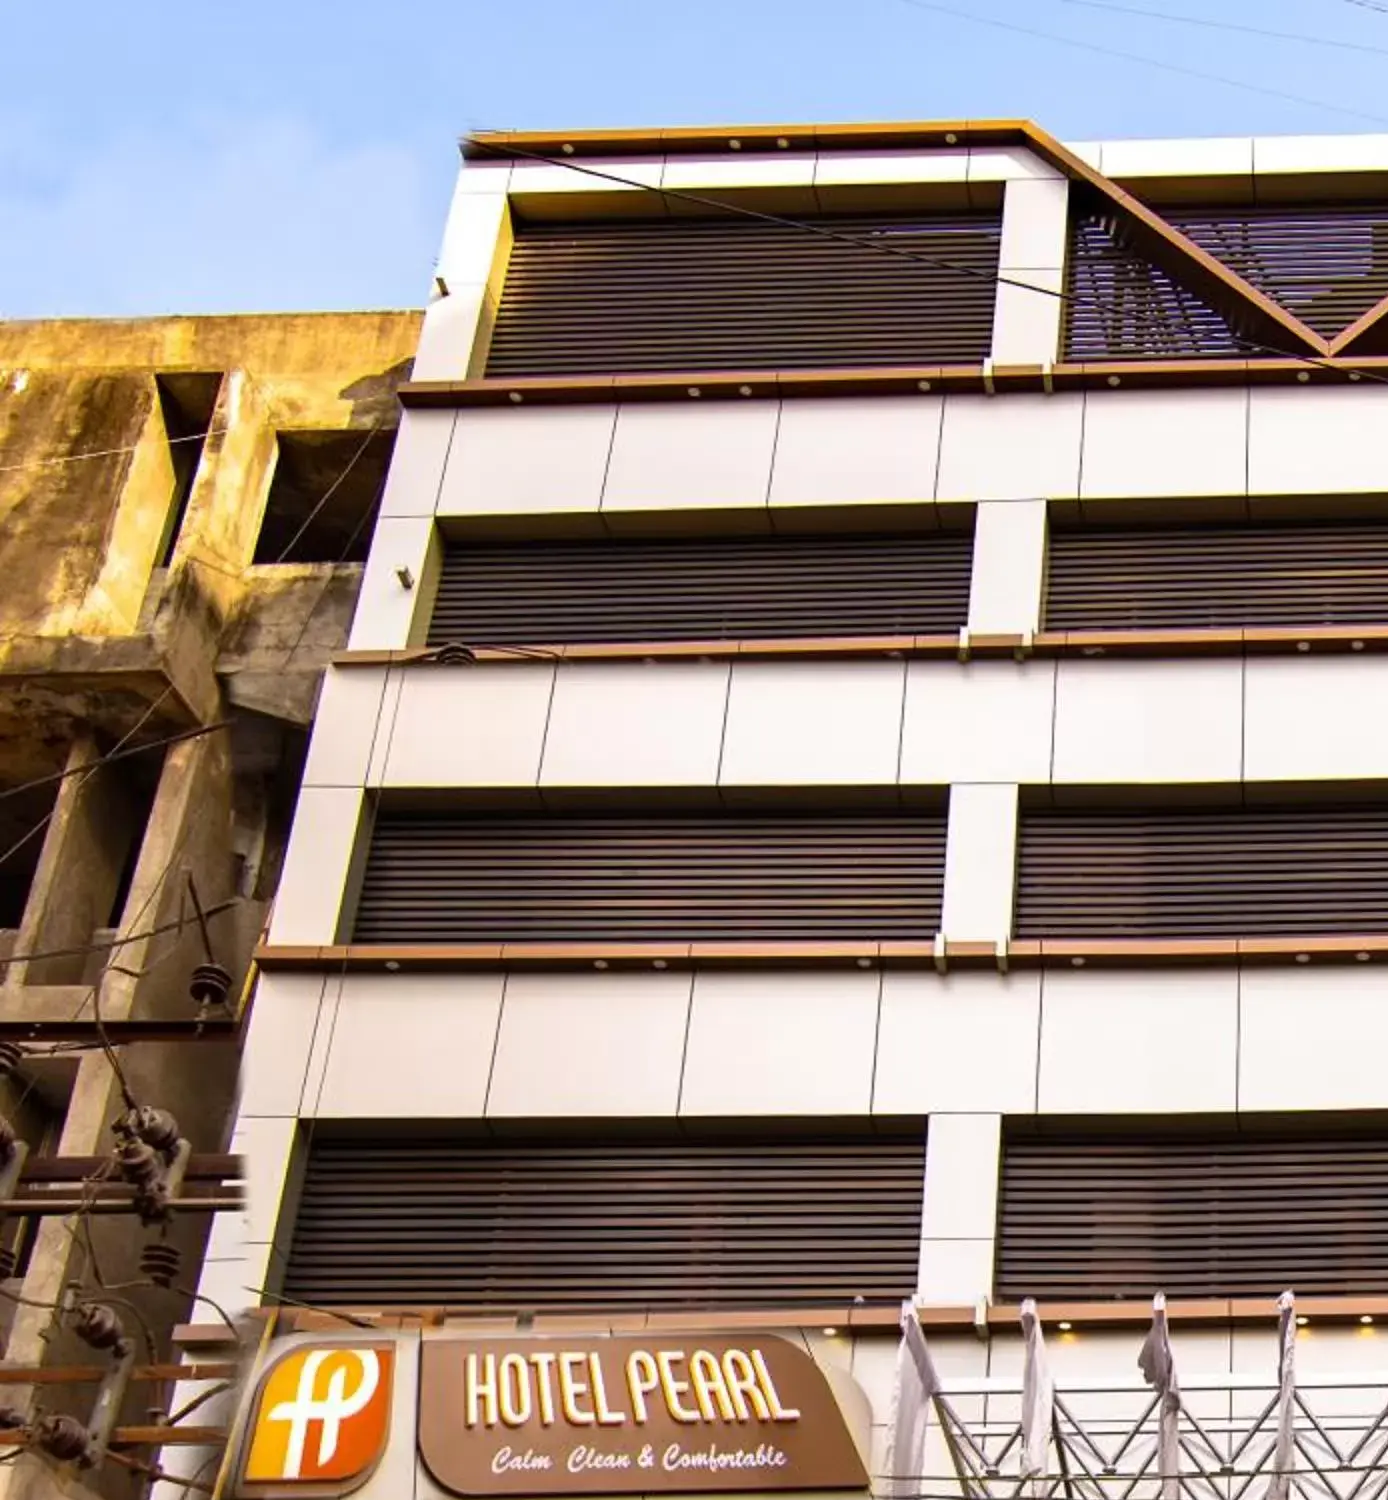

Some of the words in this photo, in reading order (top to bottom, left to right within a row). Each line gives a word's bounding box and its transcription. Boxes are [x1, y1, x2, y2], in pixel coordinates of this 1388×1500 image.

[464, 1351, 626, 1427] HOTEL
[626, 1348, 801, 1424] PEARL
[490, 1445, 553, 1475] Calm
[566, 1444, 631, 1473] Clean
[637, 1443, 655, 1469] &
[661, 1442, 788, 1474] Comfortable
